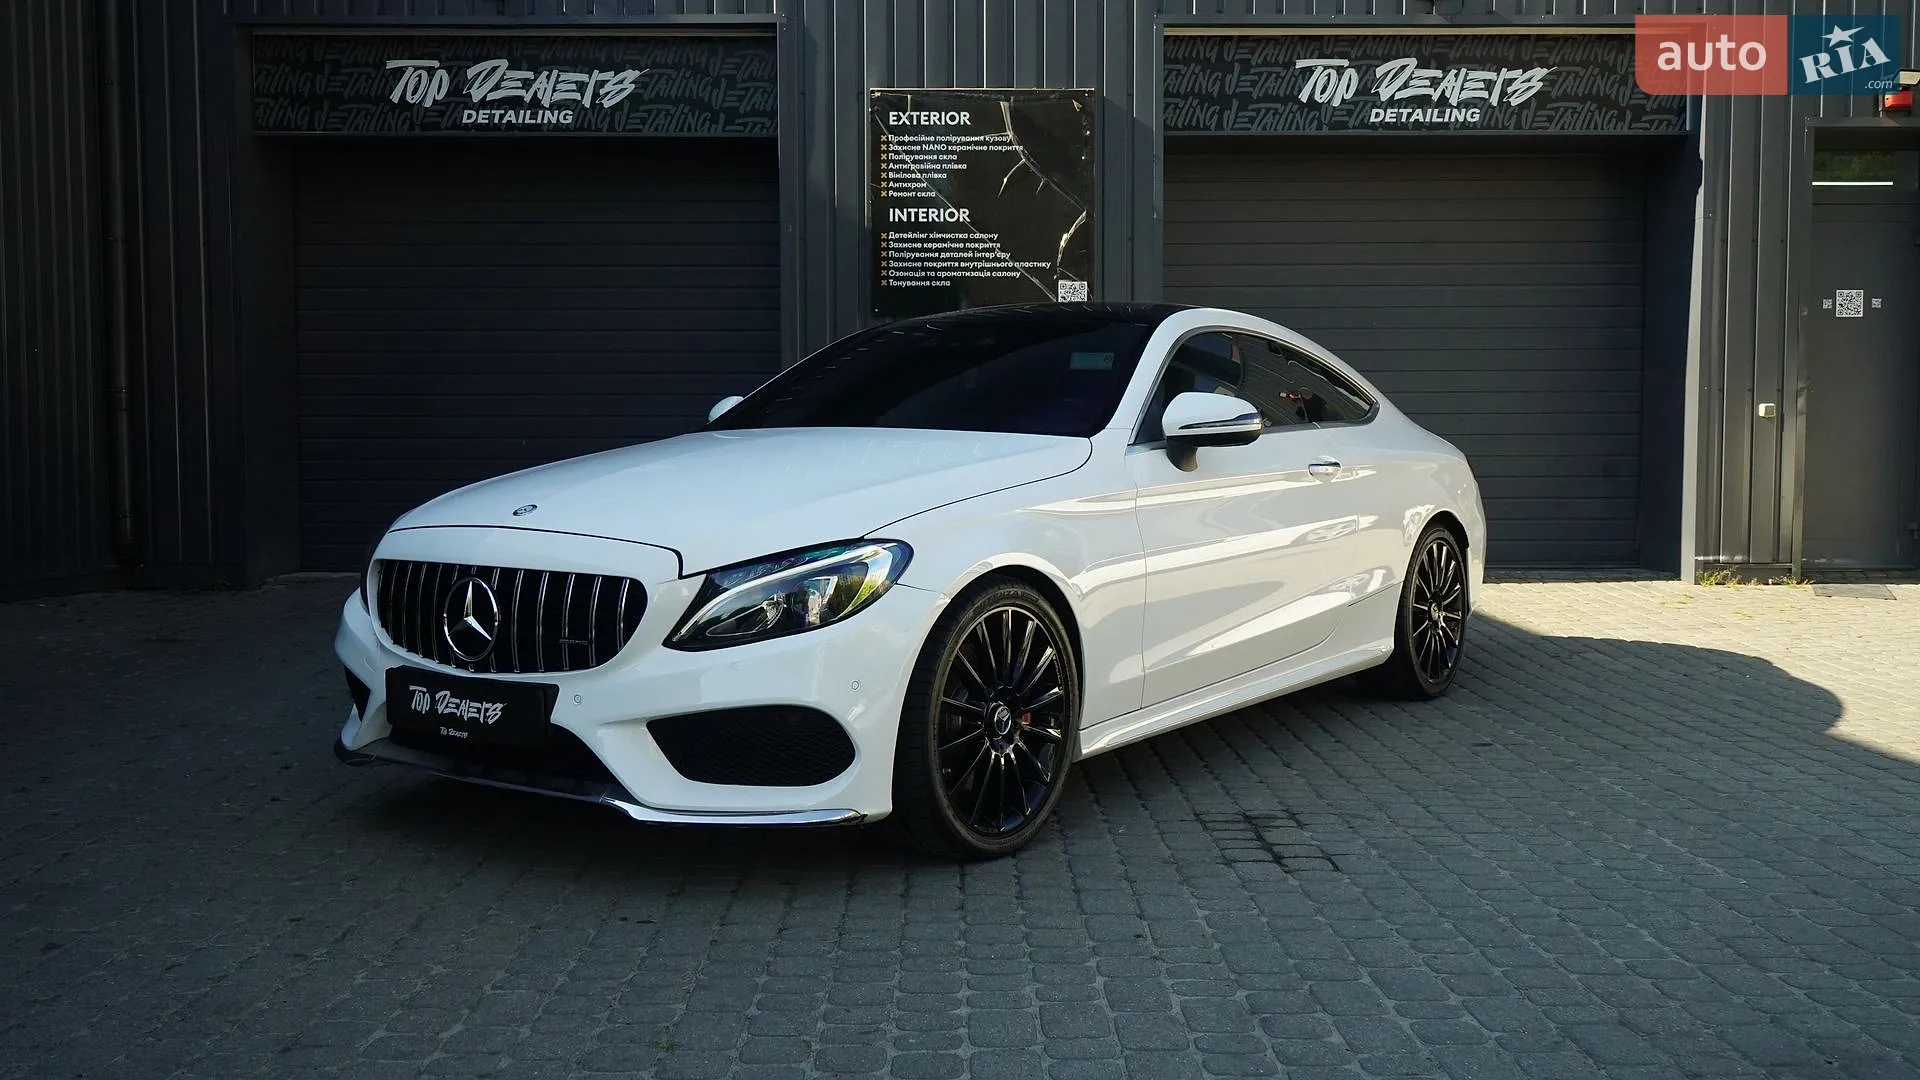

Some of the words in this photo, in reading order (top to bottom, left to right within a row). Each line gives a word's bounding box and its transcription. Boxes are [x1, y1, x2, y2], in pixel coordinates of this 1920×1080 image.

[462, 109, 573, 124] DETAILING
[889, 111, 972, 126] EXTERIOR
[1369, 108, 1480, 123] DETAILING
[889, 134, 935, 143] Професійне
[936, 134, 984, 143] полірування
[985, 134, 1011, 143] кузову
[889, 144, 921, 152] Захисне
[948, 144, 988, 152] керамічне
[889, 153, 938, 162] Полірування
[939, 153, 958, 162] скла
[942, 162, 967, 171] плівка
[922, 171, 947, 180] плівка
[889, 181, 927, 189] Антихром
[889, 190, 917, 198] Ремонт
[918, 190, 936, 198] скла
[889, 208, 971, 222] INTERIOR
[889, 231, 928, 241] Детейлінг
[929, 231, 968, 241] хімчистка
[969, 231, 999, 241] салону
[889, 241, 922, 250] Захисне
[923, 241, 964, 250] керамічне
[965, 241, 1001, 250] покриття
[889, 250, 939, 260] Полірування
[940, 250, 974, 260] деталей
[889, 260, 922, 269] Захисне
[923, 260, 959, 269] покриття
[960, 260, 1014, 269] внутрішнього
[1014, 260, 1052, 269] пластику
[889, 269, 926, 279] Озонація
[927, 269, 936, 279] та
[936, 269, 991, 279] ароматизація
[992, 269, 1021, 279] салону
[889, 279, 931, 288] Тонування
[931, 279, 951, 288] скла
